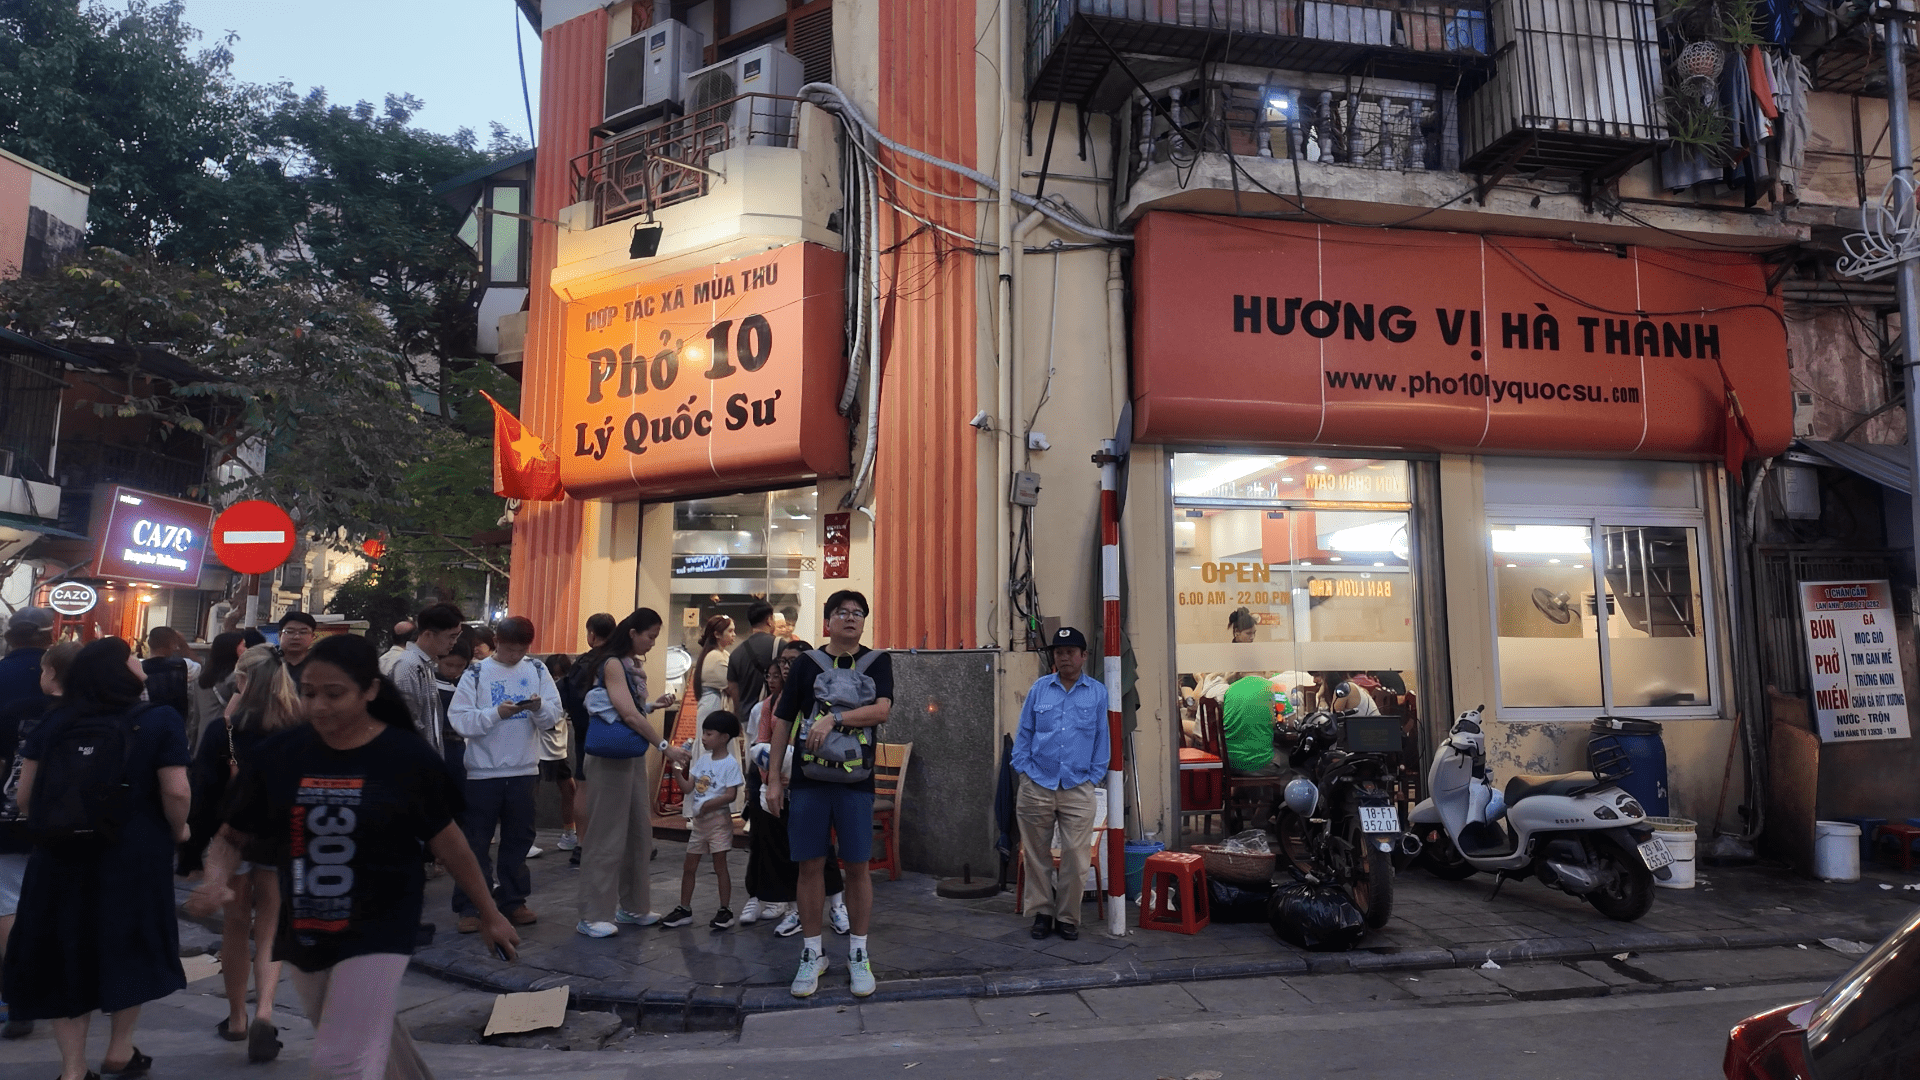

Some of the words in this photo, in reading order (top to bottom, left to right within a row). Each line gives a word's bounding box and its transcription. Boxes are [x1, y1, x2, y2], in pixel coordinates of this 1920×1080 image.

[585, 305, 618, 333] HỢP
[624, 294, 655, 323] TÁC
[660, 284, 685, 314] XÃ
[694, 274, 735, 305] MÙA
[741, 262, 778, 292] THU
[1233, 294, 1417, 343] HƯƠNG
[1435, 308, 1482, 361] VỊ
[1501, 302, 1559, 351] HÀ
[1577, 309, 1720, 359] THÀNH
[586, 329, 683, 404] Phở
[704, 313, 772, 380] 10
[575, 416, 615, 461] Lý
[623, 394, 712, 455] Quốc
[725, 389, 782, 432] Sư
[133, 519, 191, 552] CAZO
[1202, 561, 1270, 583] OPEN
[54, 590, 90, 600] CAZO
[1179, 592, 1203, 605] 6.00
[1207, 591, 1225, 605] AM
[1237, 591, 1268, 605] 22.00
[1272, 591, 1291, 605] PM
[1810, 614, 1836, 639] BÚN
[1862, 611, 1875, 626] GÀ
[1814, 647, 1840, 674] PHỞ
[1851, 653, 1864, 666] TIM
[1865, 652, 1880, 665] GAN
[1816, 682, 1849, 710] MIẾN
[1867, 711, 1890, 724] TRỘN
[1365, 807, 1393, 819] 18-F1
[1364, 820, 1398, 831] 352.07
[307, 805, 357, 897] 300
[1646, 851, 1672, 869] 255.92
